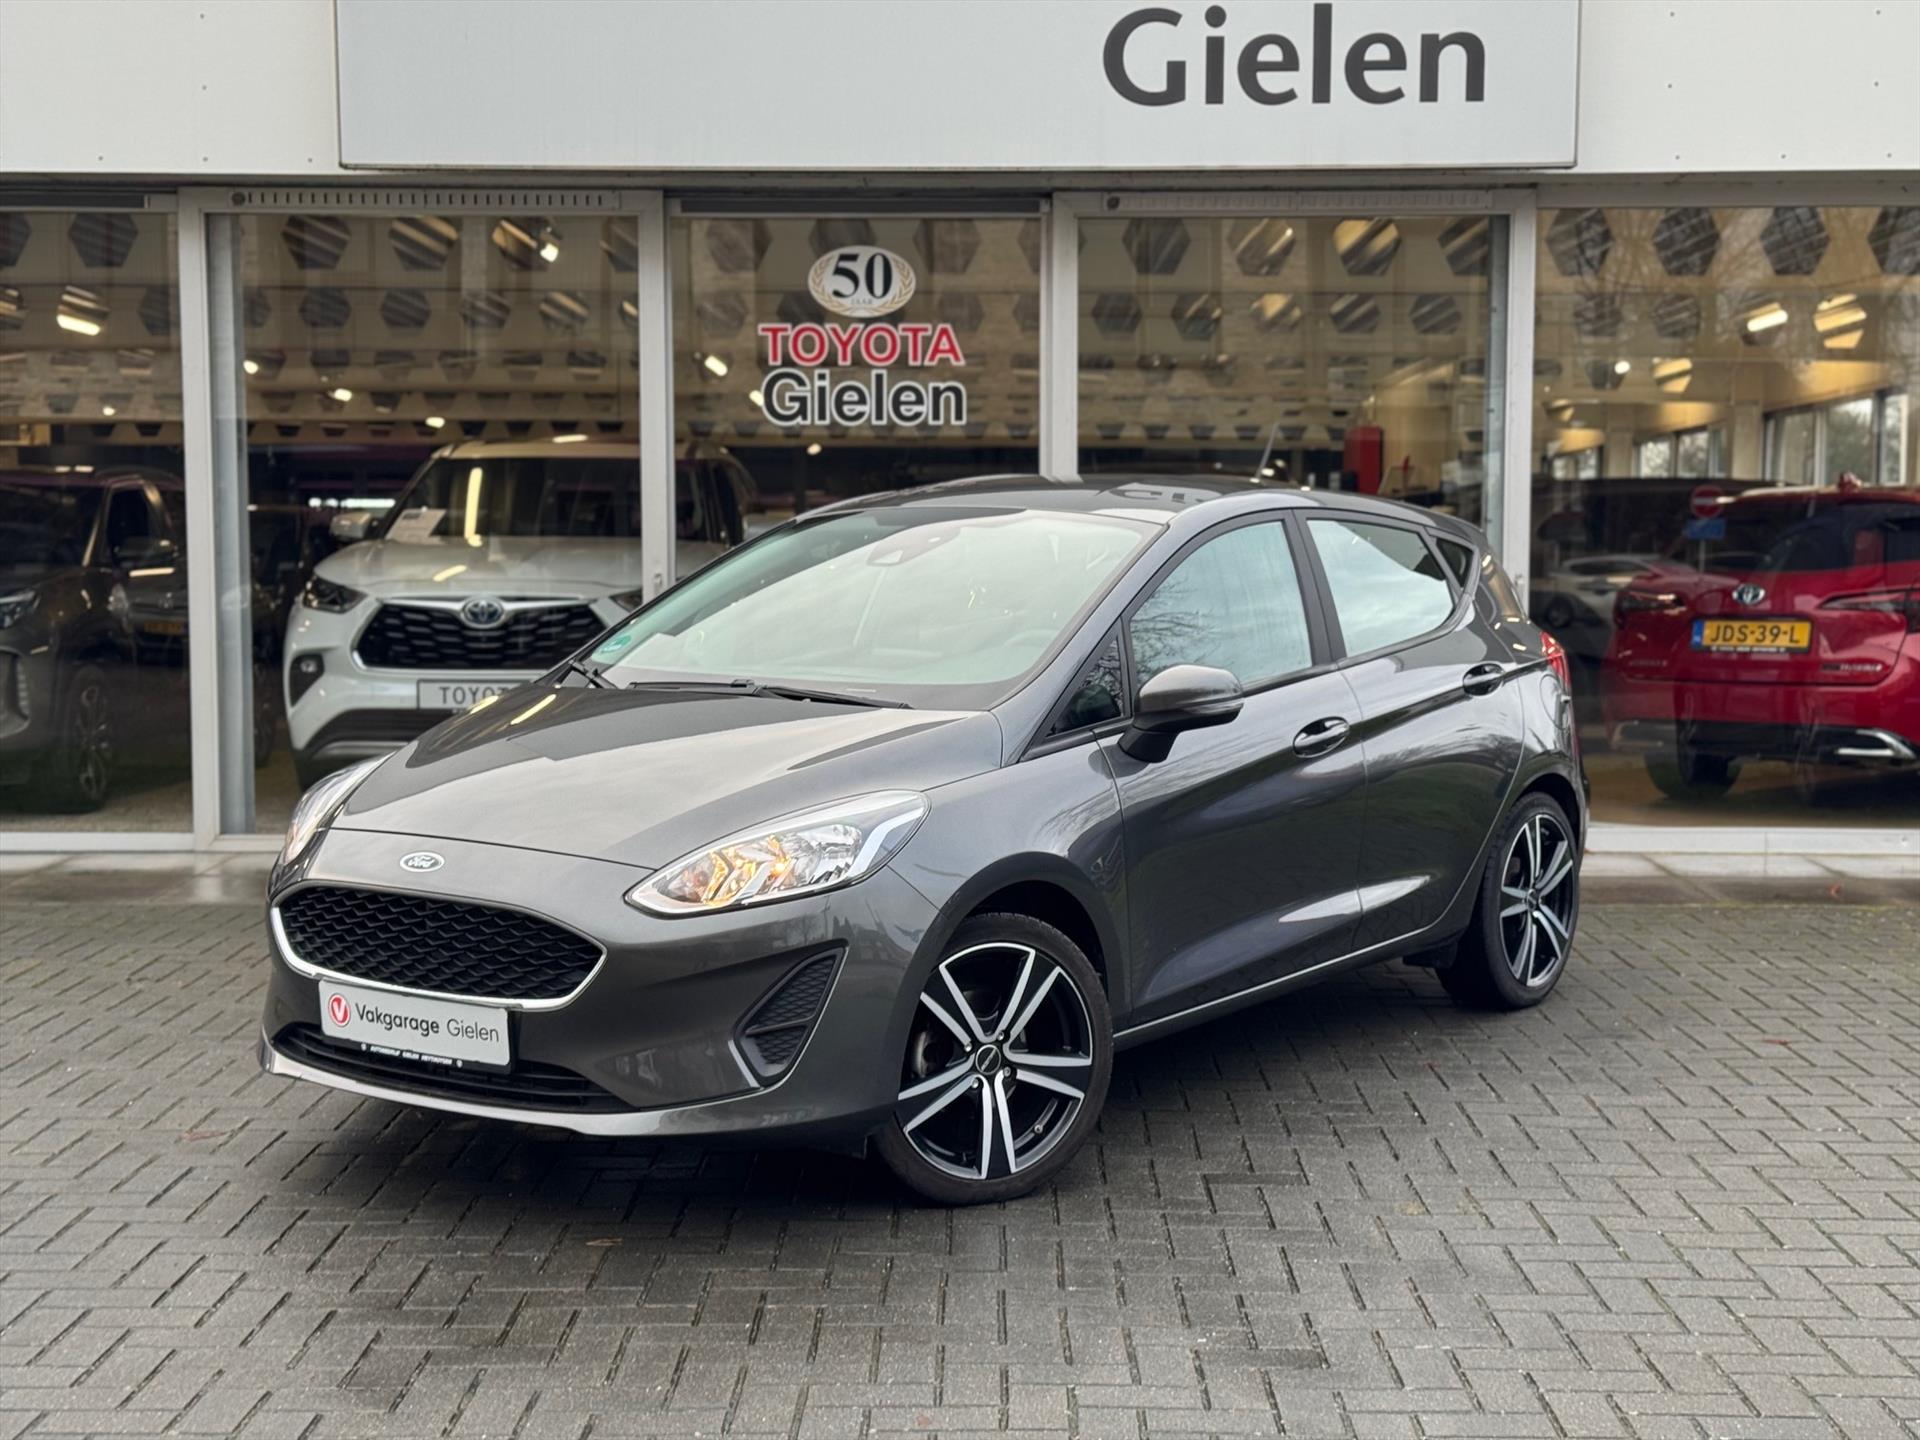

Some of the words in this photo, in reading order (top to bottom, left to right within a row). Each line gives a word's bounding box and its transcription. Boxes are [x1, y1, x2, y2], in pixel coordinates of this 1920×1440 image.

[1103, 3, 1485, 106] Gielen
[832, 252, 893, 299] 50
[759, 325, 963, 365] TOYOTA
[762, 369, 966, 425] Gielen
[1710, 624, 1800, 644] JDS-39-L
[355, 1003, 440, 1037] Vakgarage
[446, 1018, 500, 1042] Gielen
